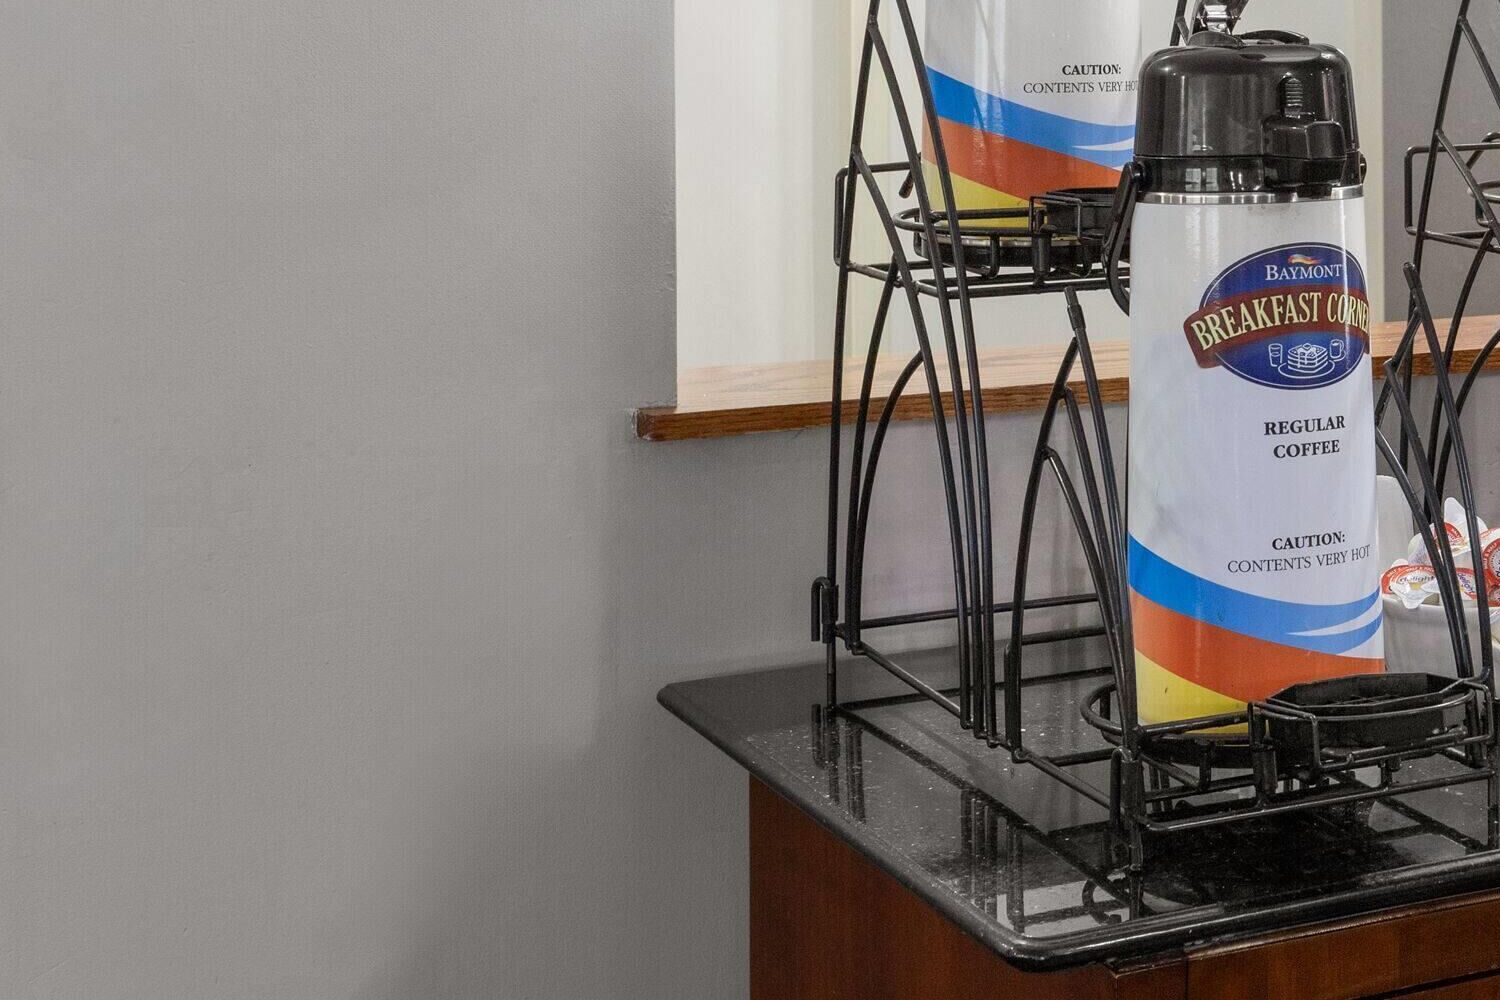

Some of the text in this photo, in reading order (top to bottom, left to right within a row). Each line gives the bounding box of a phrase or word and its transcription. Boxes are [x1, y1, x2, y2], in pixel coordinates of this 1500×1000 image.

[1062, 64, 1121, 75] CAUTION:
[1023, 82, 1095, 94] CONTENTS
[1098, 81, 1122, 92] VERY
[1265, 263, 1343, 282] BAYMONT
[1191, 292, 1369, 351] BREAKFAST CORNE
[1264, 415, 1346, 436] REGULAR
[1273, 440, 1340, 459] COFFEE
[1272, 531, 1345, 551] CAUTION:
[1227, 544, 1371, 573] CONTENTS VERY HOT
